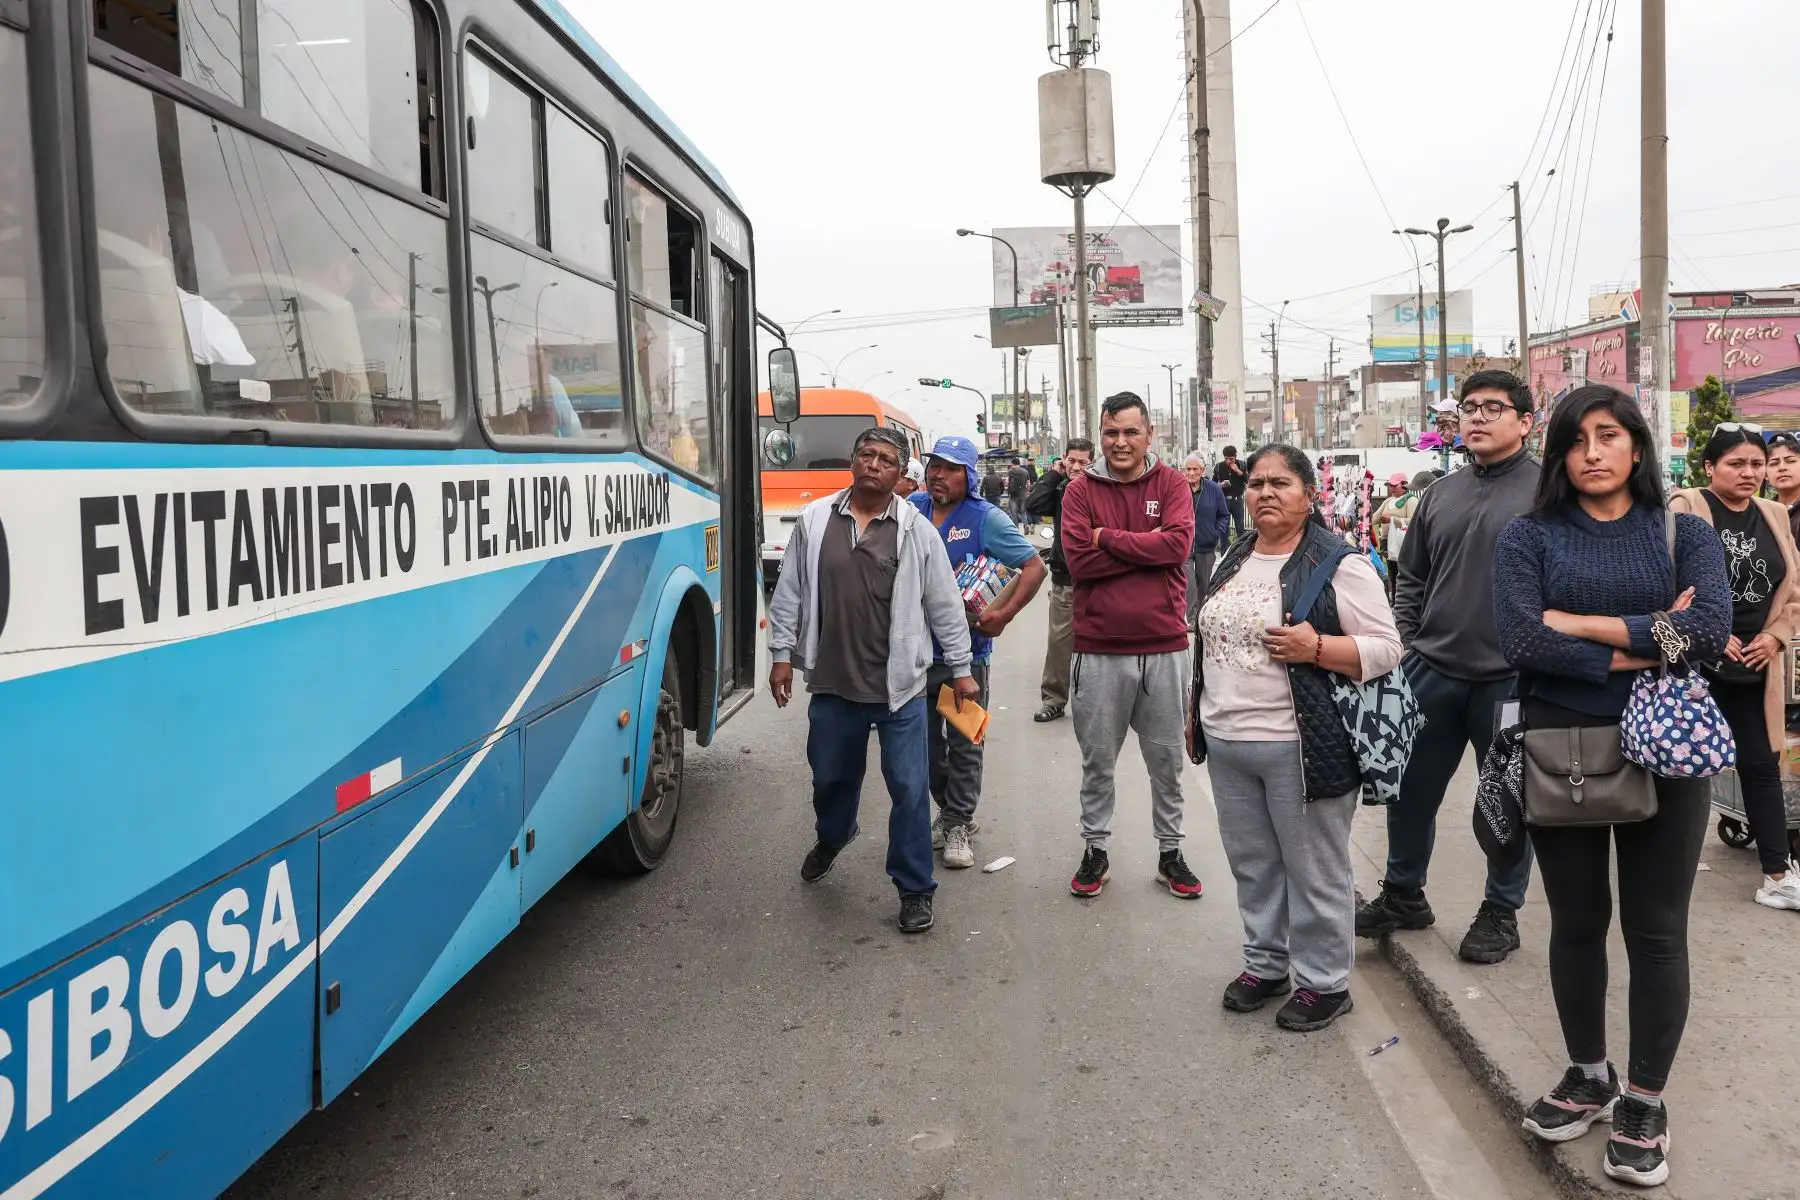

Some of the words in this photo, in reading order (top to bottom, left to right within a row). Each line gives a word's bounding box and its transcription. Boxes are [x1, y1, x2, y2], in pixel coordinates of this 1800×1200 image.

[1703, 322, 1782, 346] Imperio
[943, 380, 950, 388] 20
[80, 482, 416, 636] EVITAMIENTO
[441, 480, 498, 566] PTE.
[505, 476, 572, 554] ALIPIO
[585, 474, 600, 538] V.
[604, 473, 670, 535] SALVADOR
